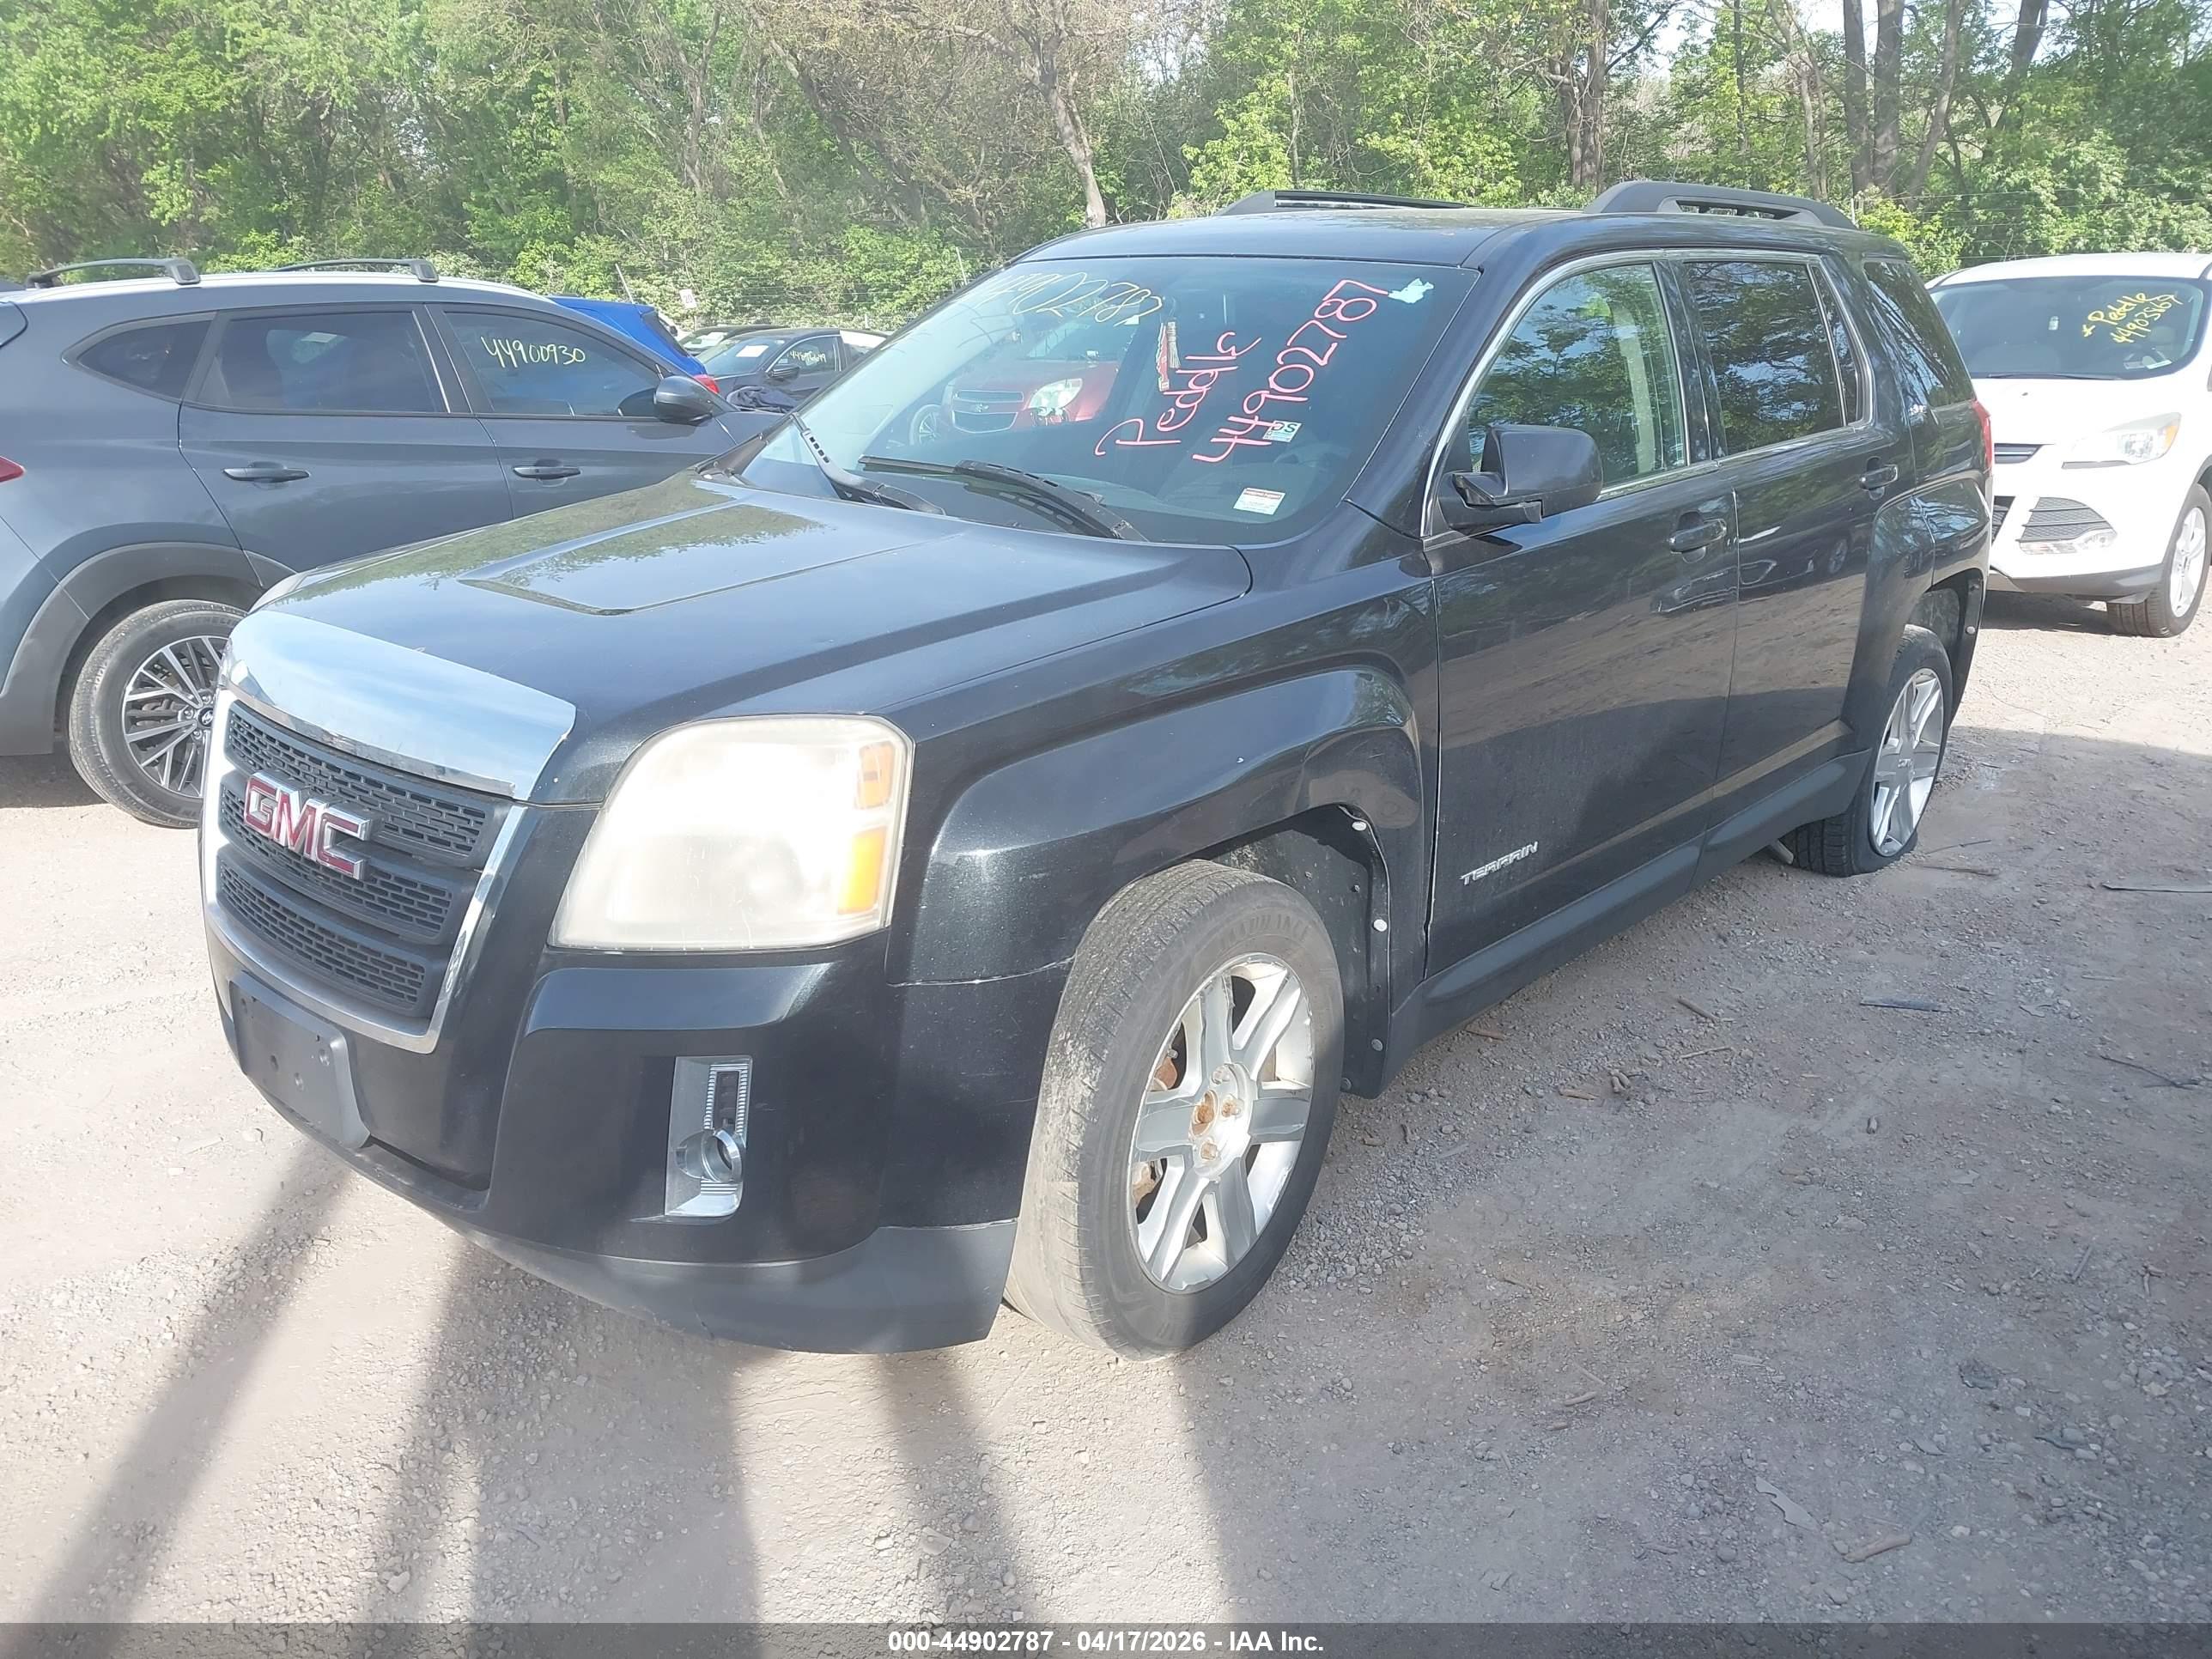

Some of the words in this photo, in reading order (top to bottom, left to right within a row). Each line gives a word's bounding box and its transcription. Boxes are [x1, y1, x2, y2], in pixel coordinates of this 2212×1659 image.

[480, 336, 586, 368] 44900930
[1193, 279, 1389, 463] 44902787
[244, 770, 376, 880] GMC
[1459, 841, 1539, 886] TERRAIN
